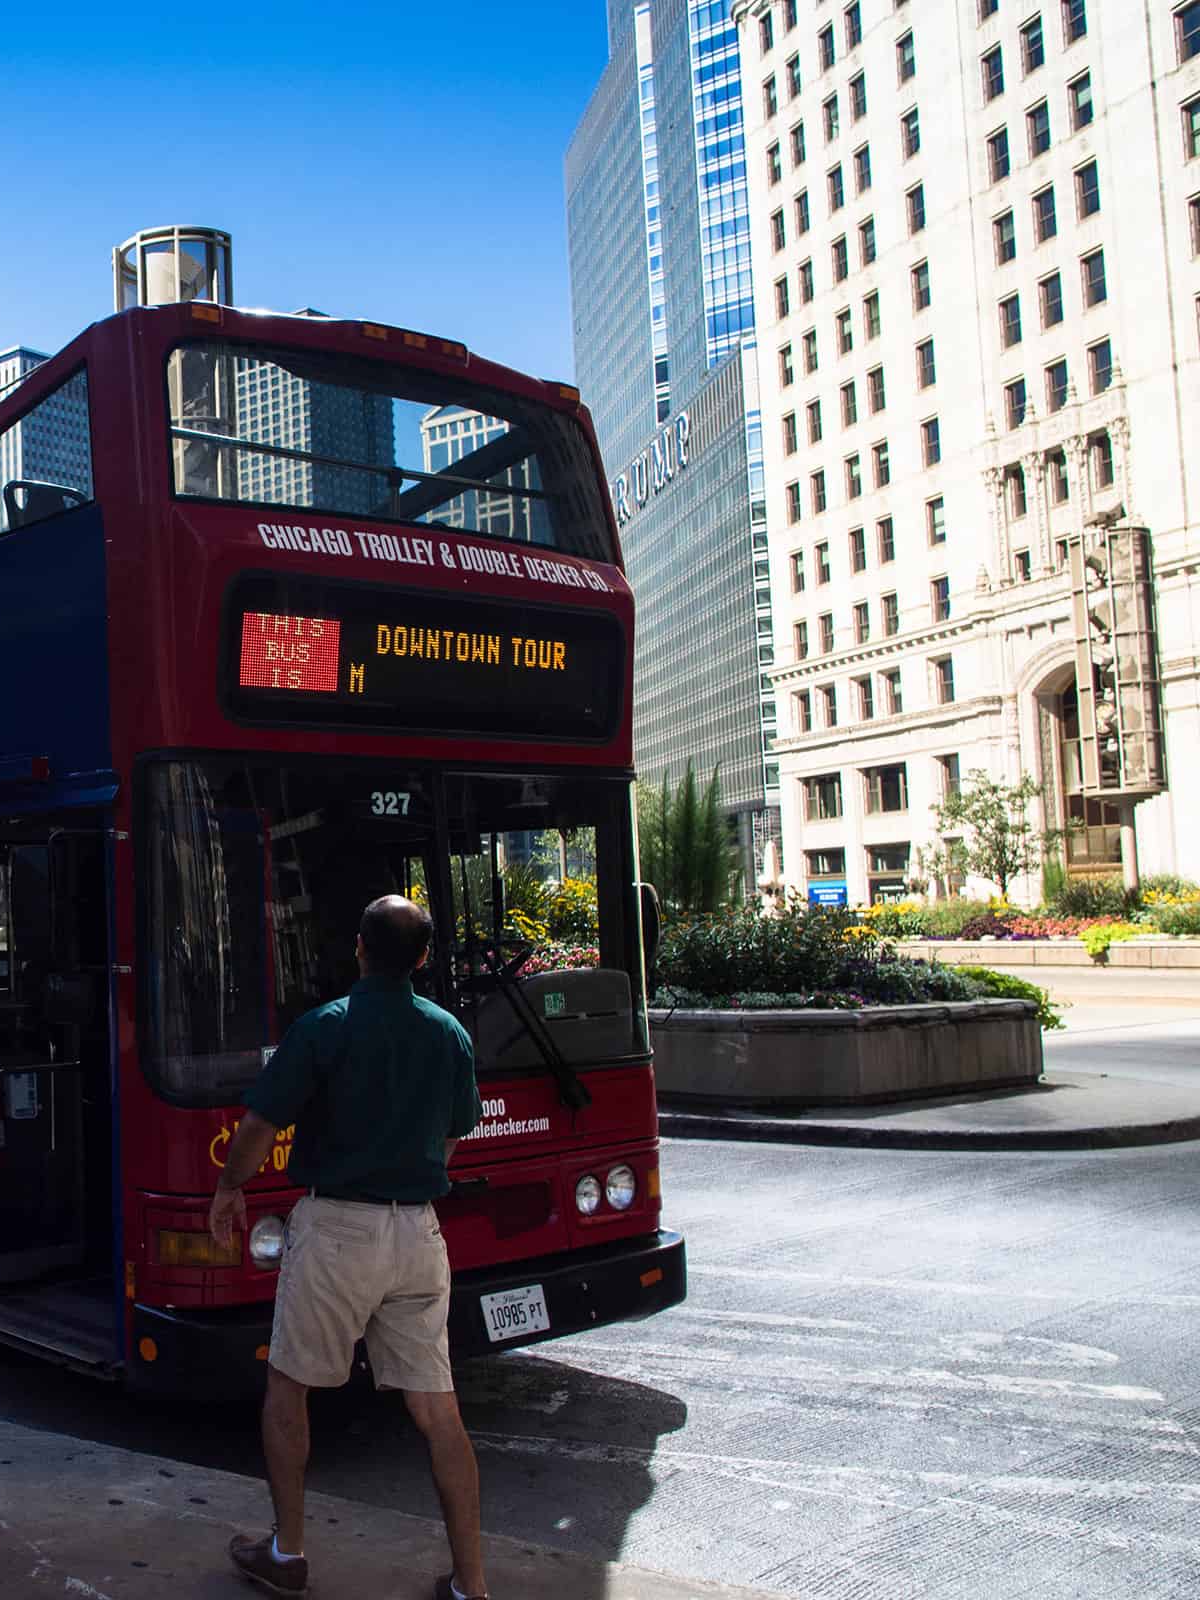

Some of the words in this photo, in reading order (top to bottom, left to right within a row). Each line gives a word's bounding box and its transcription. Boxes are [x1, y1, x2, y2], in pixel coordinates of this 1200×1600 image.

[610, 411, 690, 528] RUMP
[257, 523, 353, 557] CHICAGO
[354, 531, 435, 566] TROLLEY
[439, 542, 457, 569] &
[456, 544, 524, 578] DOUBLE
[523, 556, 586, 588] DECKER
[582, 569, 615, 593] CO.
[257, 613, 324, 636] THIS
[266, 640, 309, 662] BUS
[376, 624, 501, 665] DOWNTOWN
[511, 637, 567, 670] TOUR
[272, 667, 302, 688] IS
[349, 663, 365, 693] M
[371, 791, 410, 815] 327
[480, 1098, 506, 1118] 000
[491, 1303, 527, 1331] 10985
[529, 1302, 542, 1318] PT
